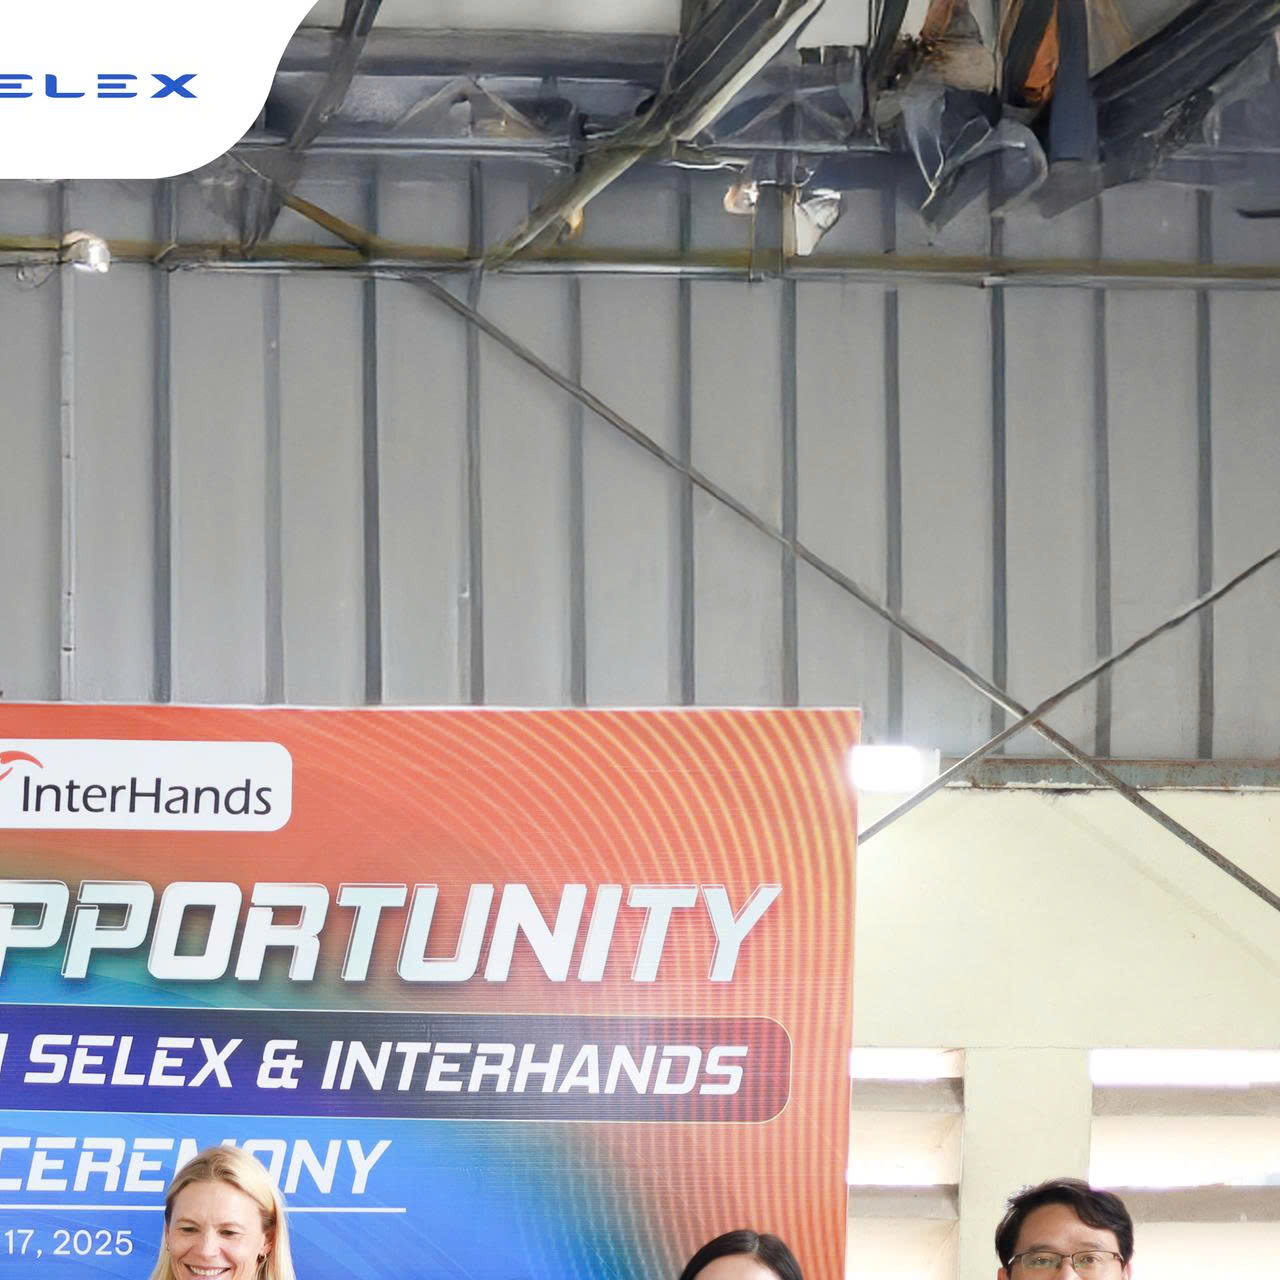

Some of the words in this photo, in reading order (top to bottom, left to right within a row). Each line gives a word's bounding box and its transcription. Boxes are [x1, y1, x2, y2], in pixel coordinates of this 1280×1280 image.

[22, 776, 272, 816] InterHands
[24, 1034, 243, 1089] SELEX
[257, 1038, 304, 1090] &
[321, 1041, 749, 1097] INTERHANDS
[4, 1229, 43, 1258] 17,
[52, 1229, 133, 1256] 2025
